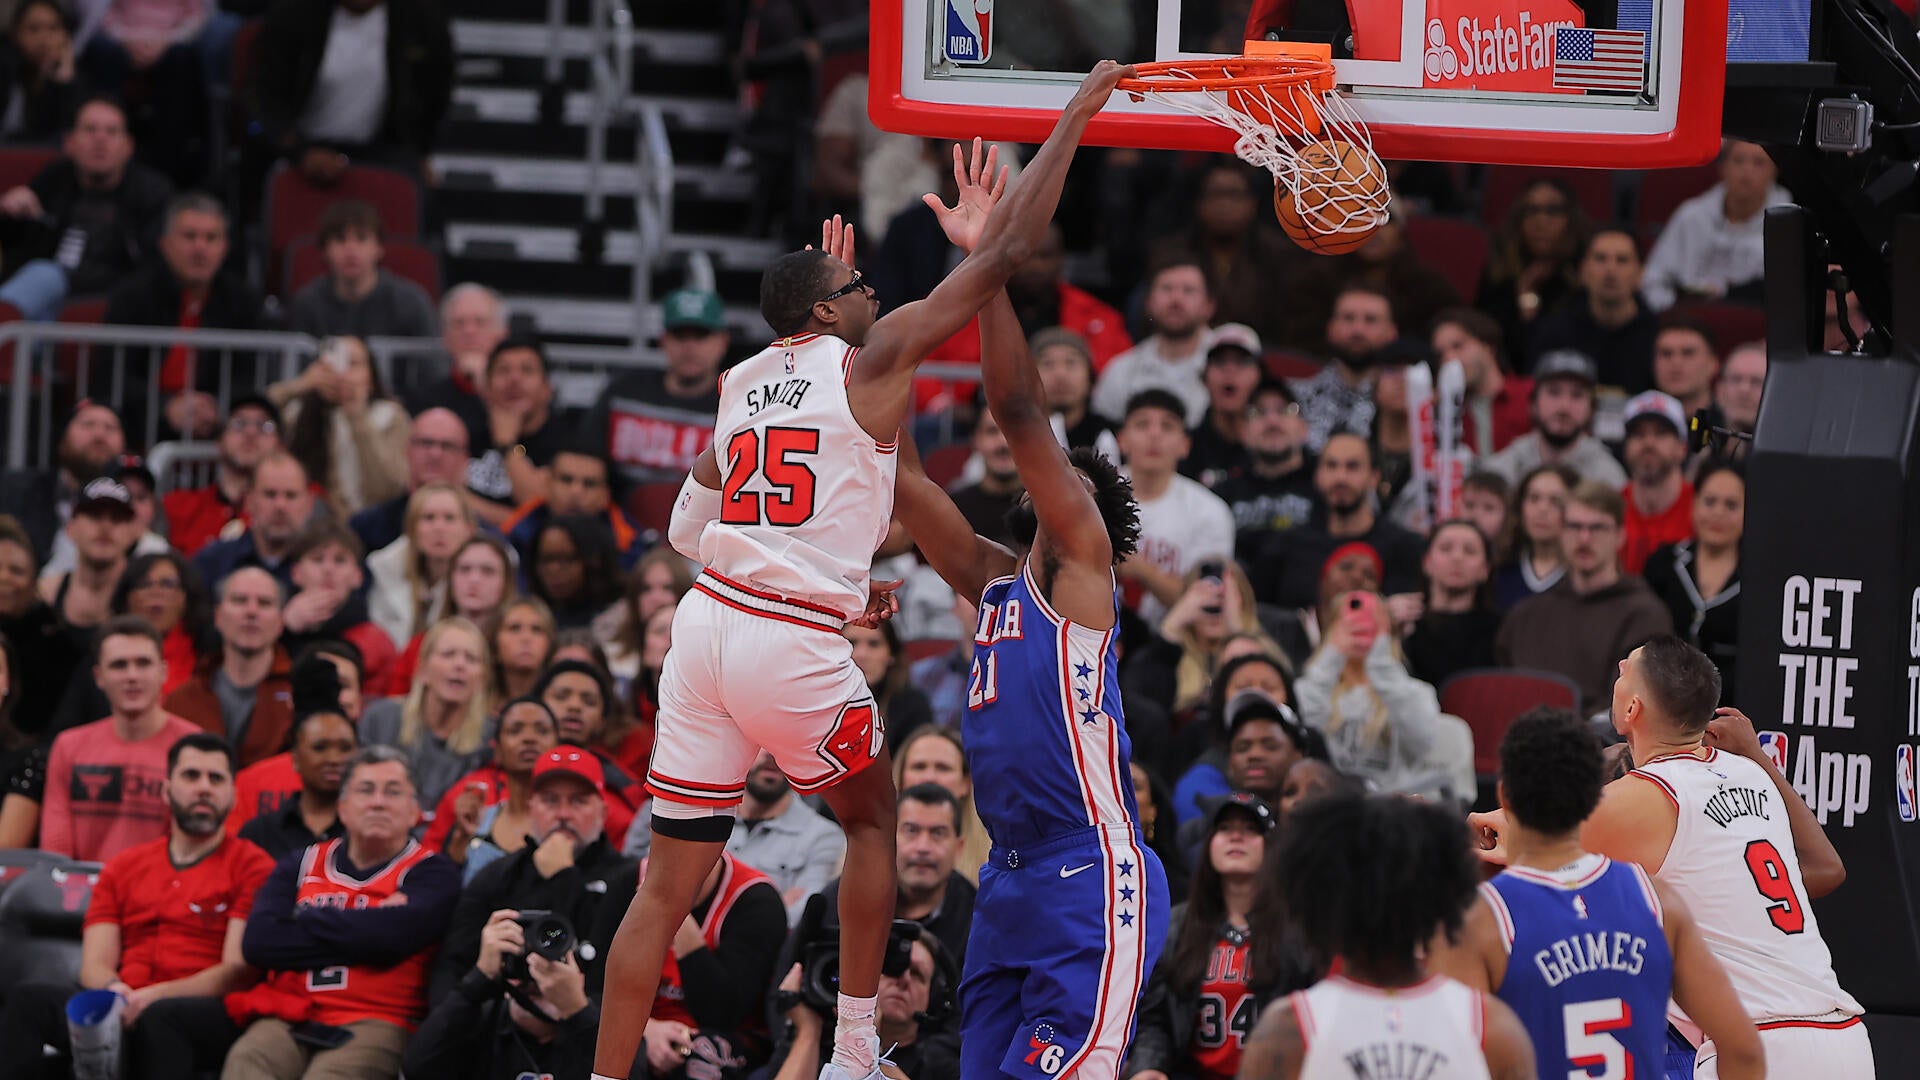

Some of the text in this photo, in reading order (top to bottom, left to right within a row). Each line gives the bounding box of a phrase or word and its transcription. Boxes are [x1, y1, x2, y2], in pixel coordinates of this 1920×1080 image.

[950, 35, 974, 56] NBA
[747, 359, 812, 417] SMITH
[720, 426, 820, 527] 25
[1781, 574, 1863, 650] GET
[968, 649, 998, 712] 21
[1778, 653, 1859, 729] THE
[1703, 783, 1770, 829] VUČEVIĆ
[1792, 734, 1872, 828] App
[1744, 839, 1805, 935] 9
[1534, 930, 1647, 987] GRIMES
[1197, 991, 1259, 1050] 34
[1563, 998, 1634, 1080] 5
[1023, 1034, 1065, 1075] 76
[1344, 1042, 1449, 1080] WHITE
